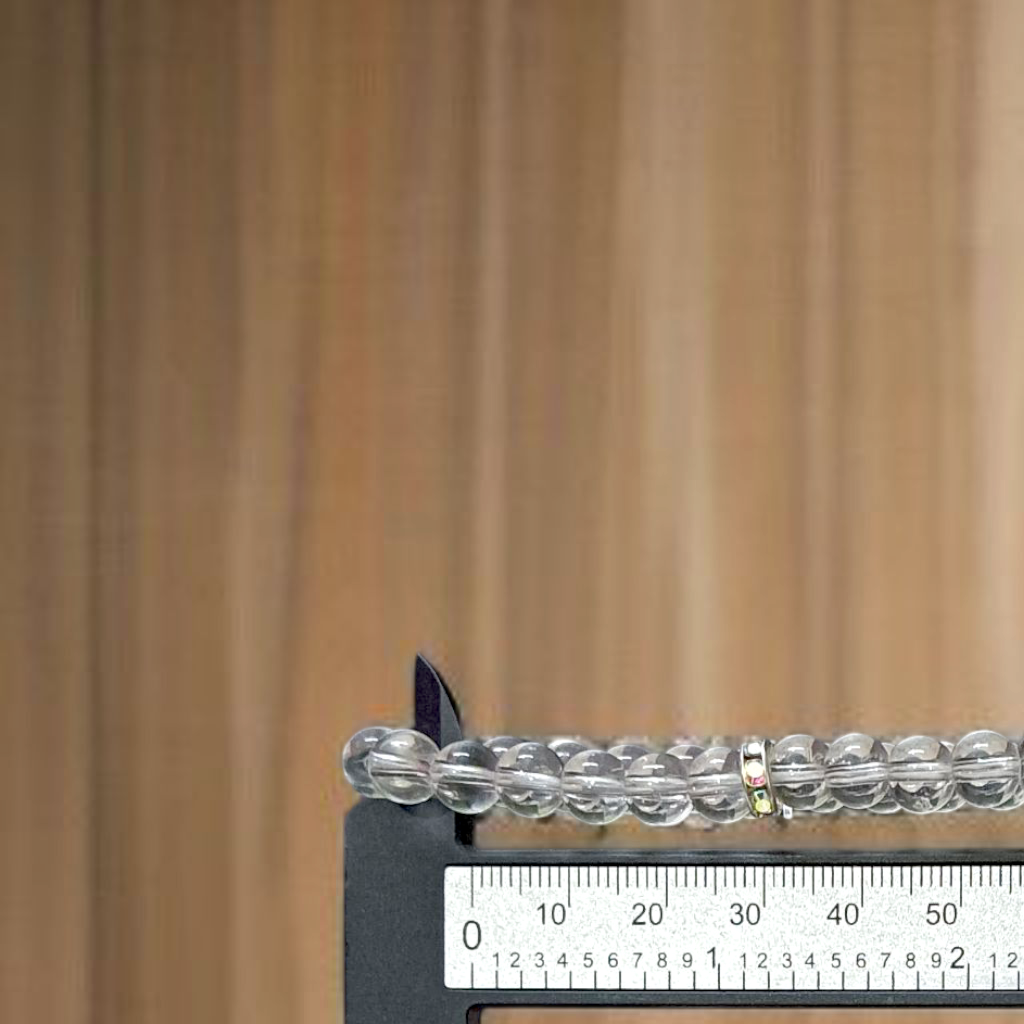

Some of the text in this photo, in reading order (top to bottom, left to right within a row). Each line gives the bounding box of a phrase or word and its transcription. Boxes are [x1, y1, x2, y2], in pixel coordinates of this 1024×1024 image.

[537, 903, 566, 925] 10
[632, 903, 663, 925] 20
[729, 903, 761, 925] 30
[827, 903, 859, 926] 40
[926, 903, 957, 925] 50
[462, 921, 481, 950] 0
[492, 953, 499, 967] 1
[510, 953, 521, 968] 2
[534, 953, 544, 968] 3
[557, 953, 568, 968] 4
[583, 953, 593, 968] 5
[608, 953, 618, 968] 6
[633, 953, 643, 968] 7
[657, 953, 668, 968] 8
[682, 953, 692, 968] 9
[707, 947, 717, 968] 1
[740, 953, 746, 968] 1
[758, 953, 768, 968] 2
[782, 953, 792, 968] 3
[804, 953, 815, 968] 4
[831, 953, 841, 968] 5
[856, 953, 866, 968] 6
[881, 953, 891, 968] 7
[905, 953, 916, 968] 8
[931, 953, 941, 968] 9
[951, 947, 965, 969] 2
[989, 953, 996, 968] 1
[1007, 952, 1018, 968] 2
